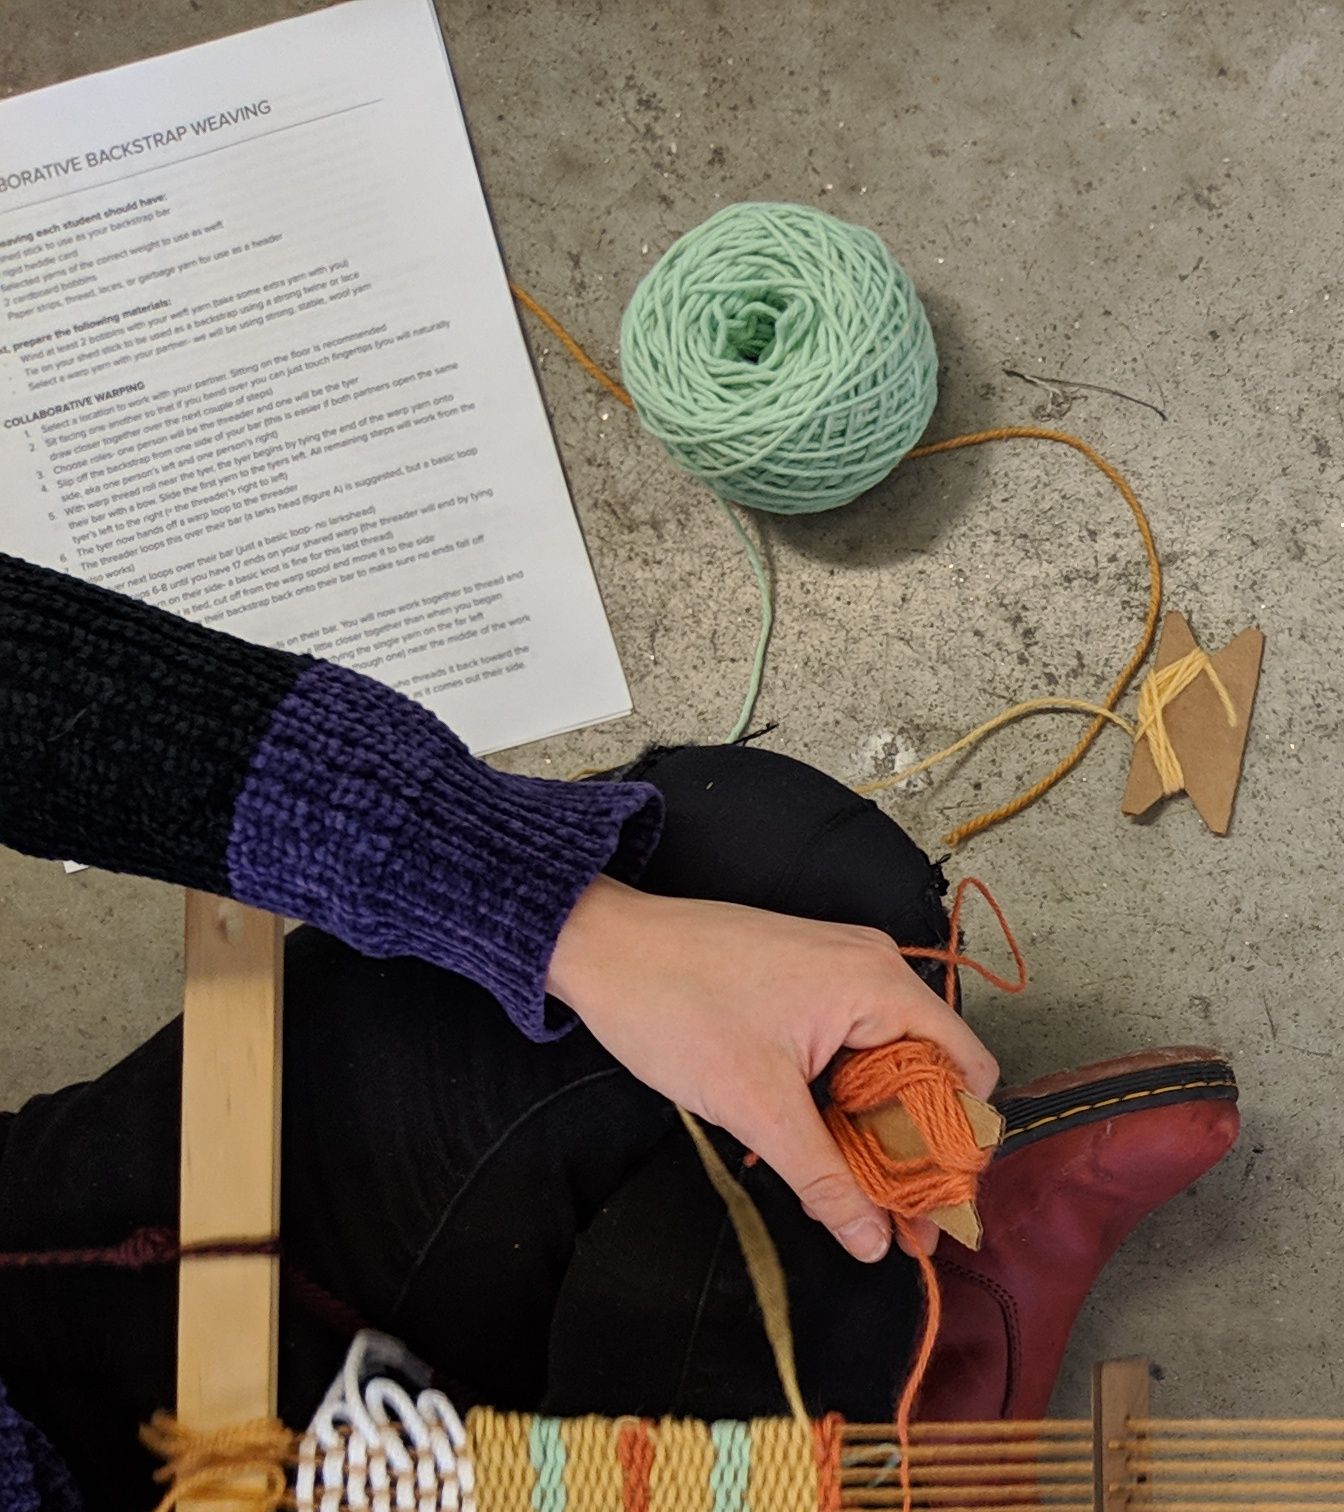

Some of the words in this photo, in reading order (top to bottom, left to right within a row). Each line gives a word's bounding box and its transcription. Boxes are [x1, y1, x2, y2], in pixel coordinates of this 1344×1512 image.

[84, 125, 188, 168] BACKSTRAP
[188, 99, 272, 136] WEAVING
[34, 223, 61, 238] each
[61, 211, 102, 230] student
[102, 200, 138, 219] should
[138, 192, 168, 208] have:
[11, 333, 53, 353] prepare
[53, 327, 72, 339] the
[71, 313, 121, 333] following
[120, 298, 172, 319] materials:
[3, 395, 94, 429] COLLABORATIVE
[93, 380, 146, 403] WARPING
[312, 640, 334, 653] little
[334, 631, 363, 647] closer
[362, 619, 402, 638] together
[402, 613, 425, 626] than
[425, 605, 453, 619] when
[452, 600, 472, 614] you
[470, 592, 503, 607] began
